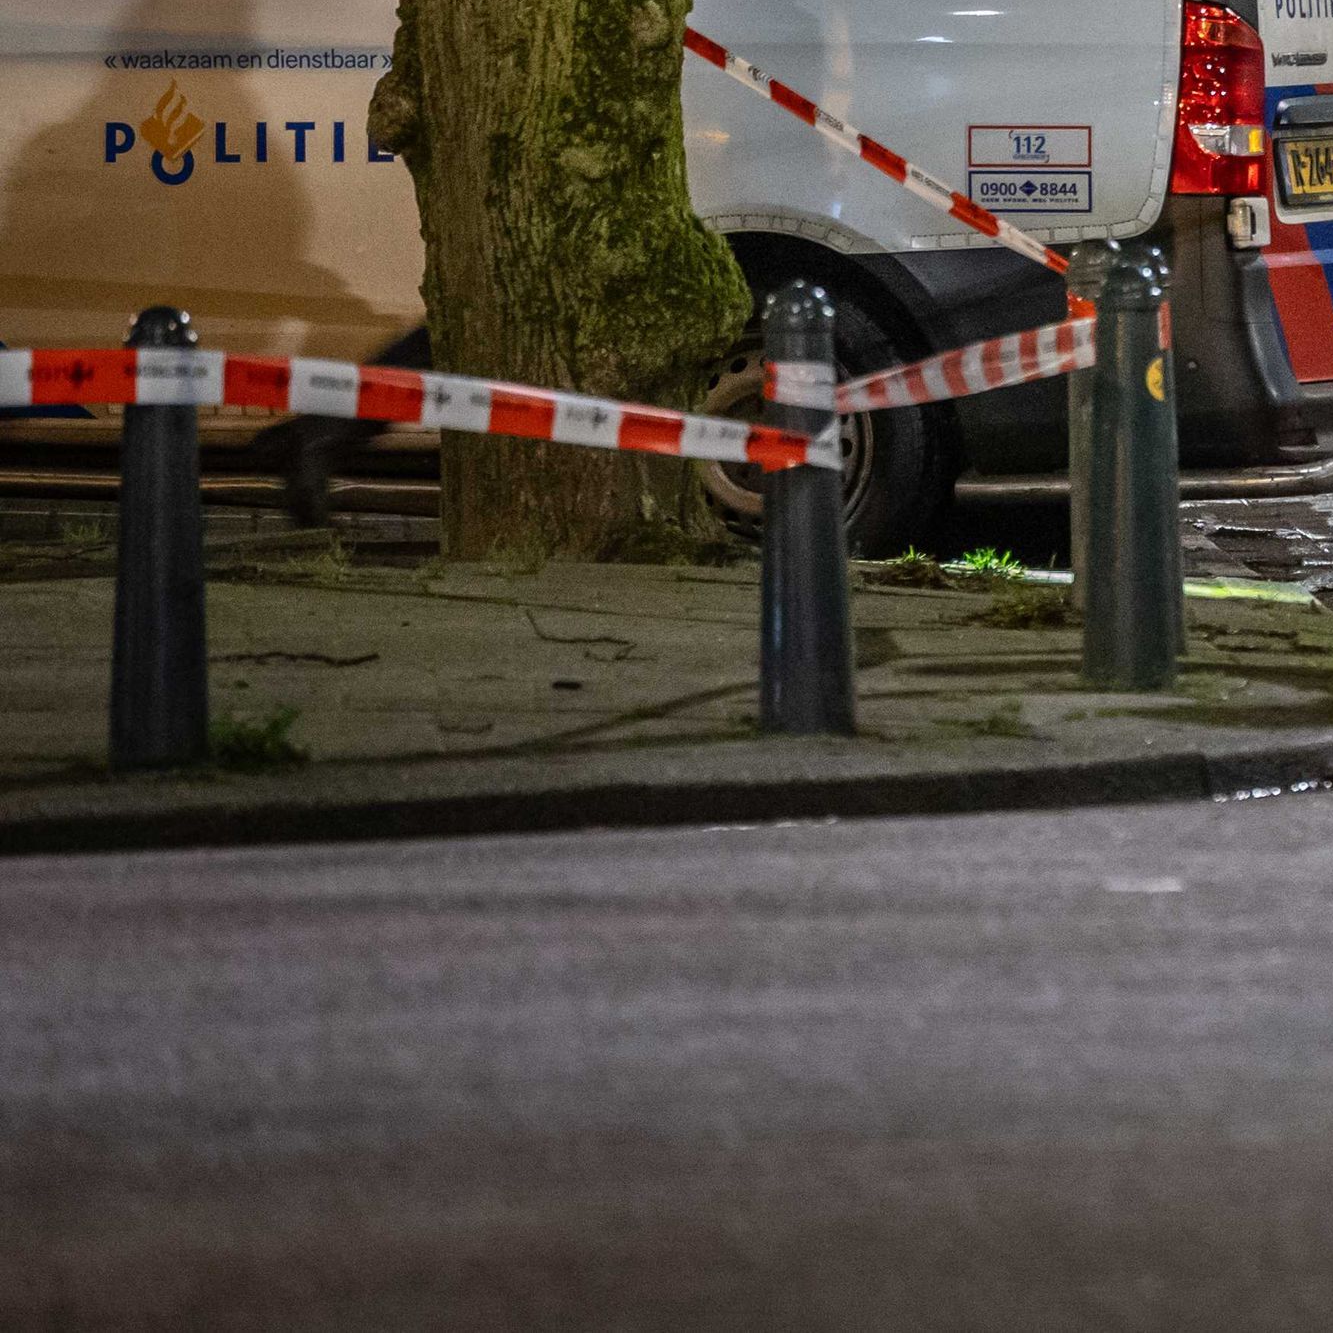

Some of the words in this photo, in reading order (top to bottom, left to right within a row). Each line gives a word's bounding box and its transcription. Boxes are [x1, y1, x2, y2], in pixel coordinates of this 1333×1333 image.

[122, 49, 231, 70] waakzaam
[237, 54, 262, 70] en
[267, 48, 376, 70] dienstbaar
[981, 182, 1017, 196] 0900
[1039, 182, 1077, 196] 8844
